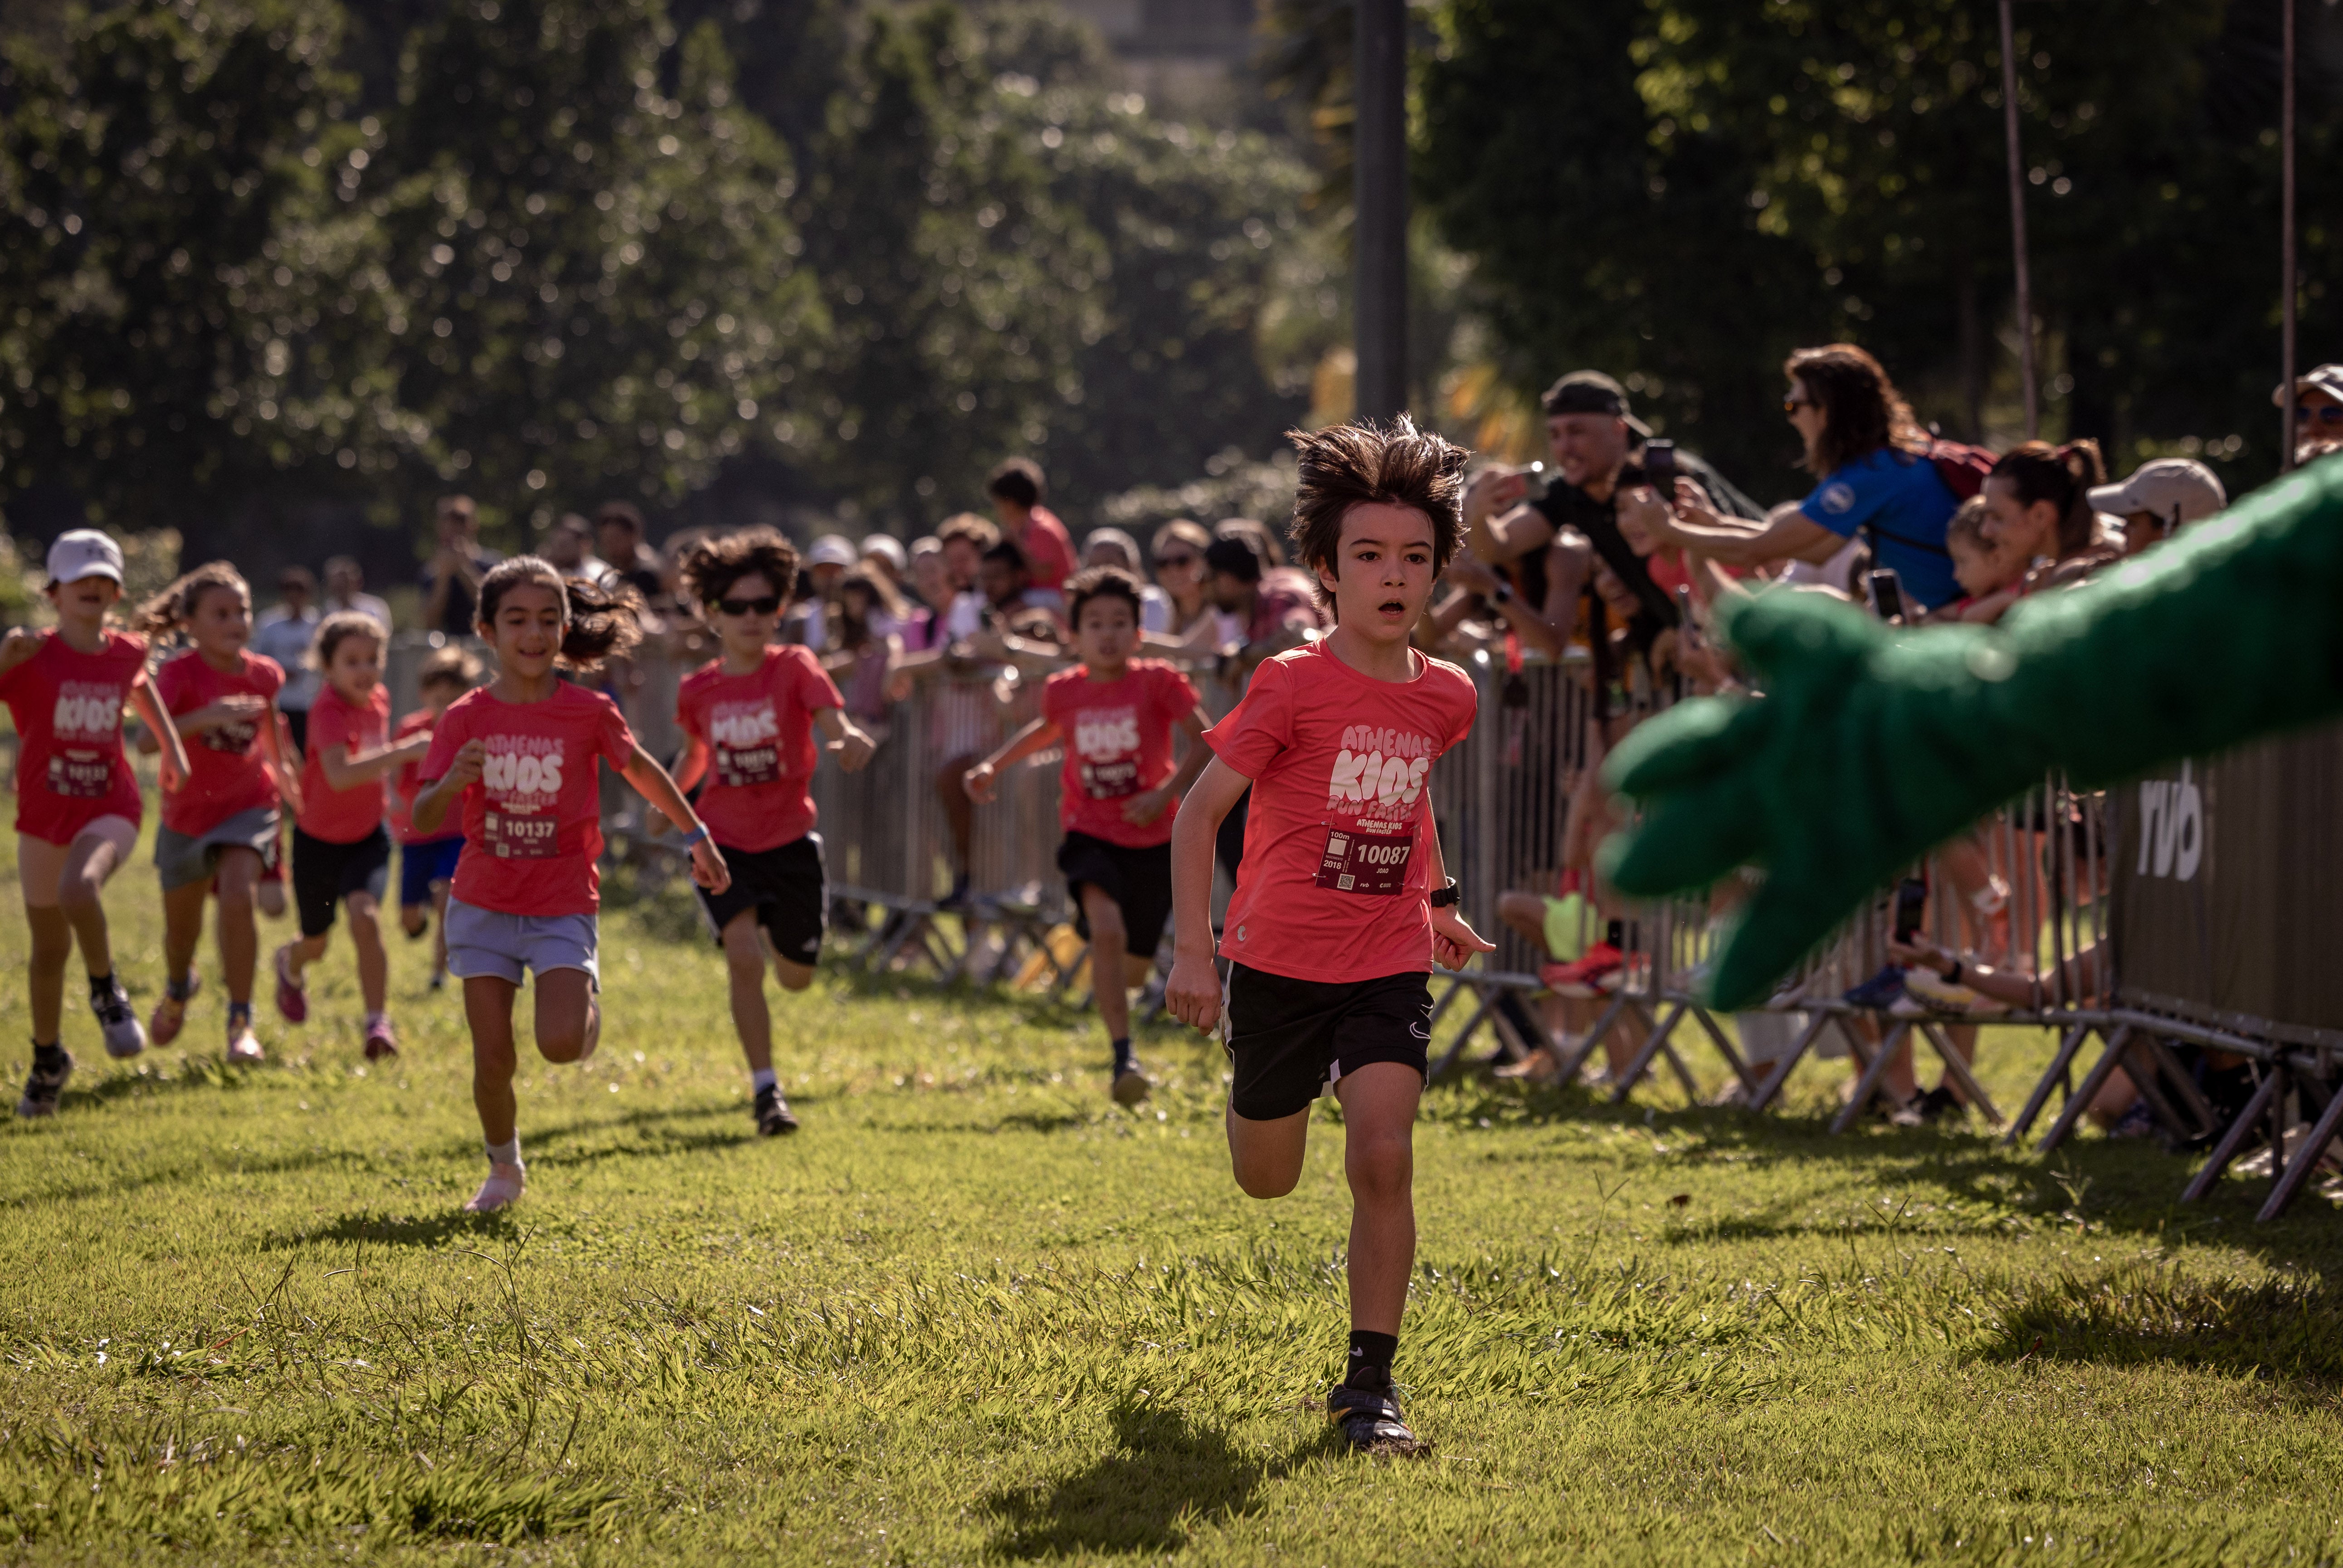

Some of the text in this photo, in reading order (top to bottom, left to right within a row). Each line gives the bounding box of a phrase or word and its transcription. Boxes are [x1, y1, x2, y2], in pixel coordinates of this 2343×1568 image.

[1341, 725, 1431, 759] ATHENAS
[482, 751, 564, 794] KIDS
[1330, 749, 1428, 807] KIDS
[1326, 795, 1415, 821] RUN FASTER
[506, 821, 555, 838] 10137
[1357, 819, 1387, 829] ATHENAS
[1330, 832, 1349, 840] 100m
[1323, 860, 1341, 869] 2018
[1358, 844, 1410, 865] 10087
